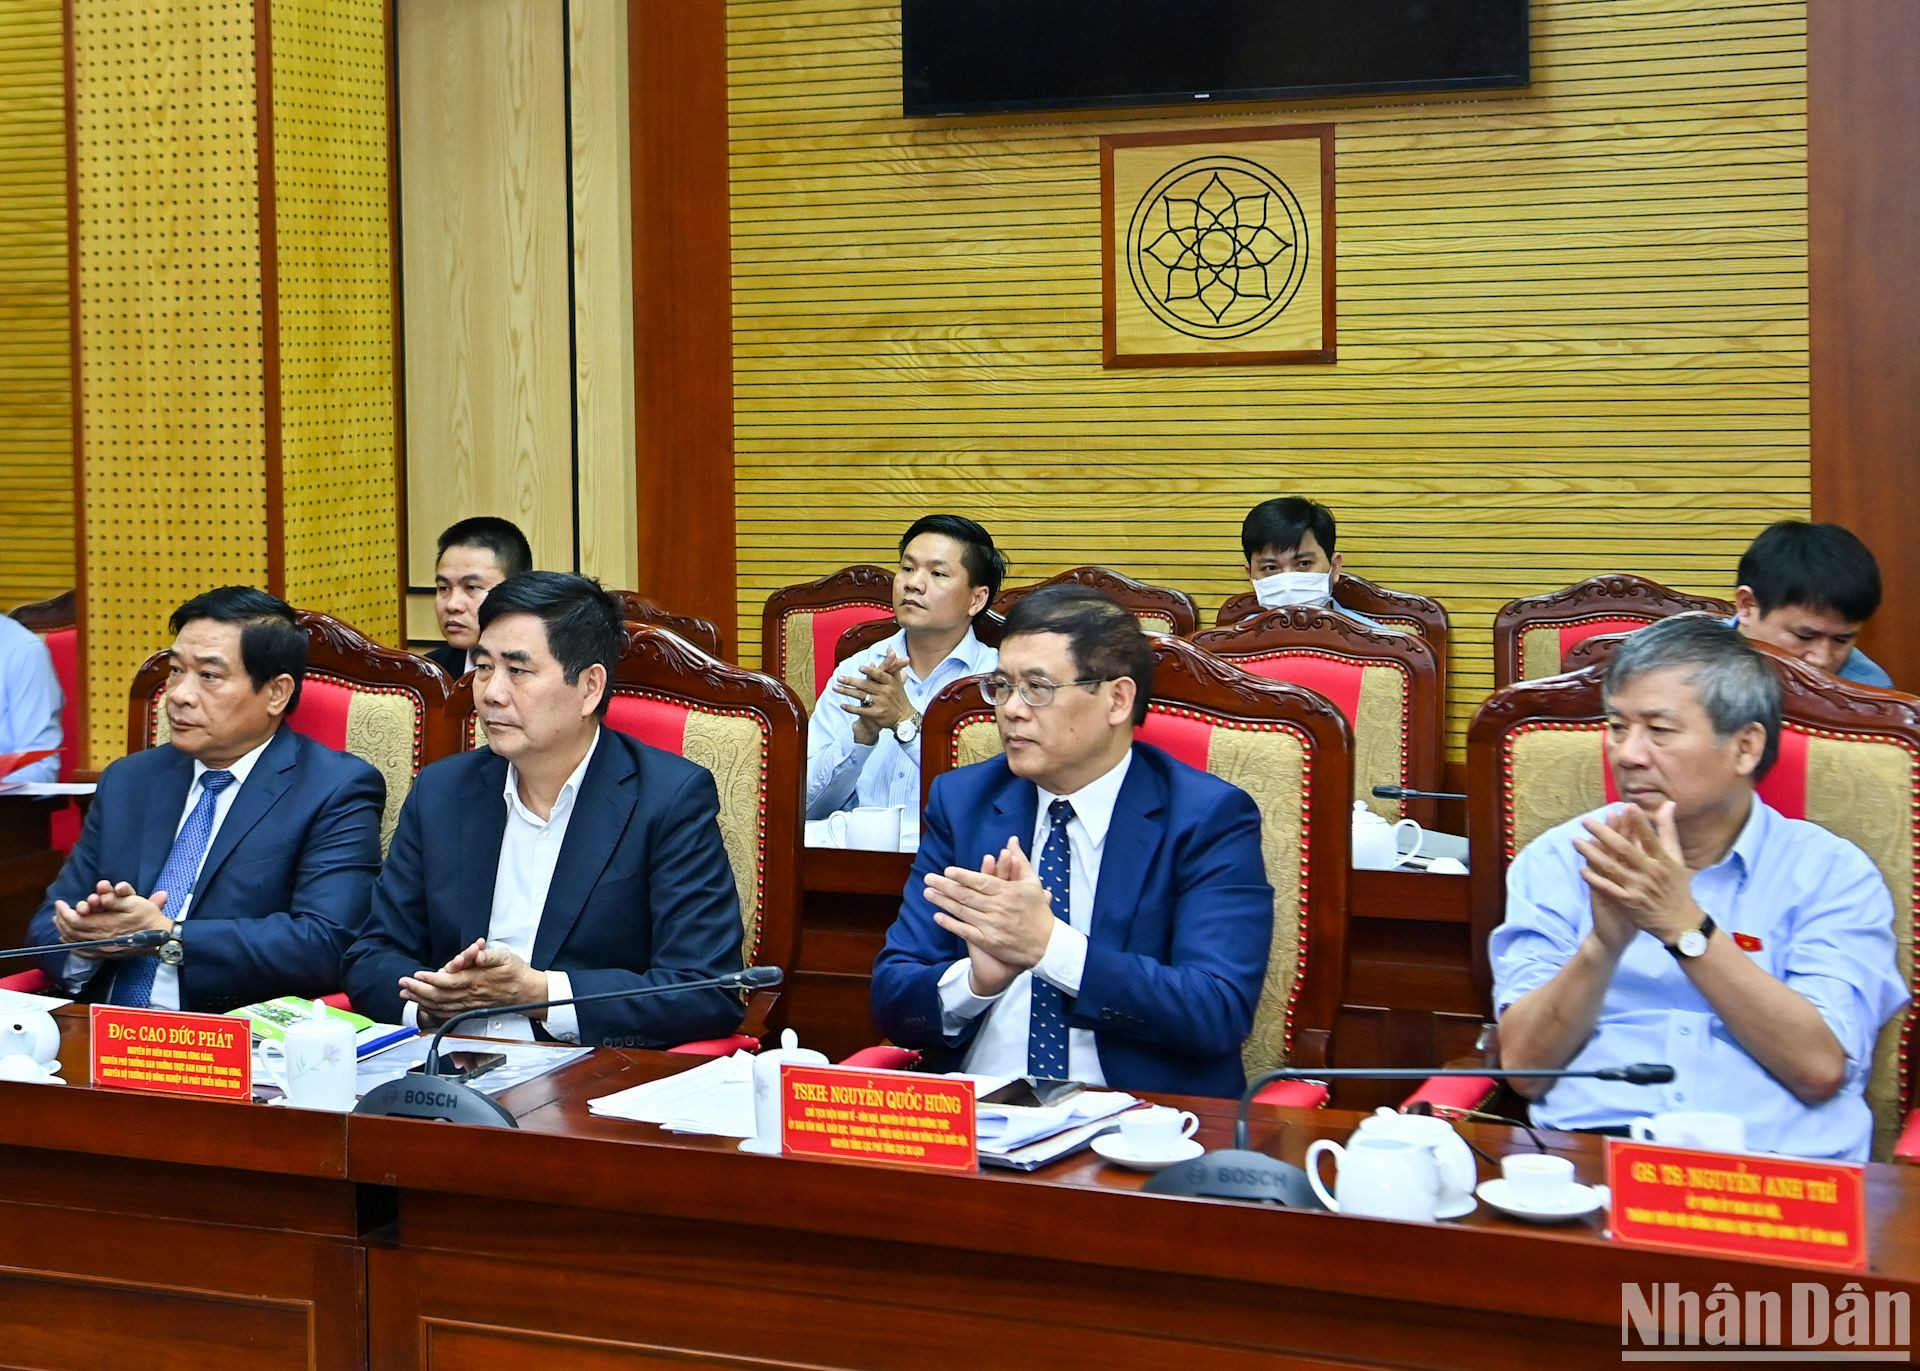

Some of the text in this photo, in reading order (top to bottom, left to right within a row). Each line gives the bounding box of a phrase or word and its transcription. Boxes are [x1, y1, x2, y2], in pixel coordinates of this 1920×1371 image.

[108, 1023, 234, 1049] Đ/c: CAO ĐỨC PHÁT
[404, 1090, 458, 1108] BOSCH
[886, 1085, 922, 1111] QUỐC
[1218, 1167, 1287, 1189] BOSCH
[1763, 1176, 1804, 1200] ANH
[1805, 1176, 1838, 1204] TRÍ
